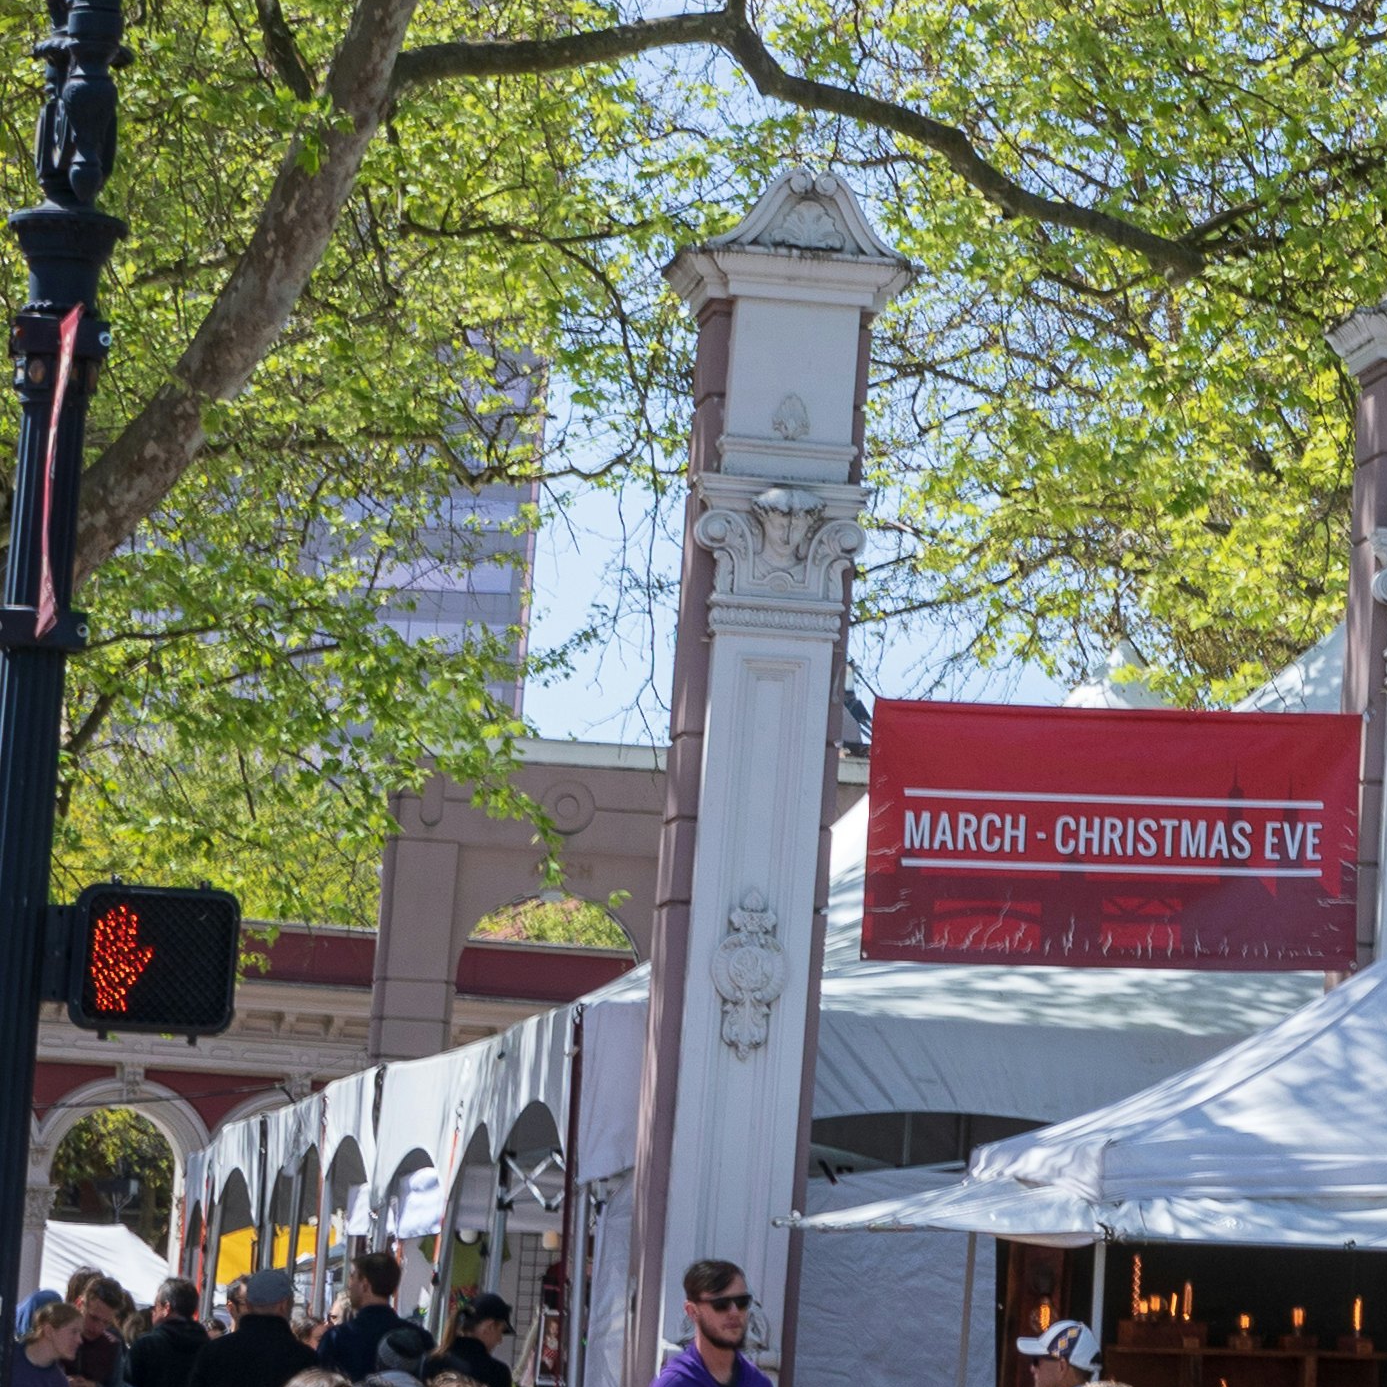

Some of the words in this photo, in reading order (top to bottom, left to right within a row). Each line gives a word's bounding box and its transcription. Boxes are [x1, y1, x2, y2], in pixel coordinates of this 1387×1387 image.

[903, 810, 1026, 853] MARCH
[1055, 814, 1252, 860] CHRISTMAS
[1264, 821, 1322, 861] EVE
